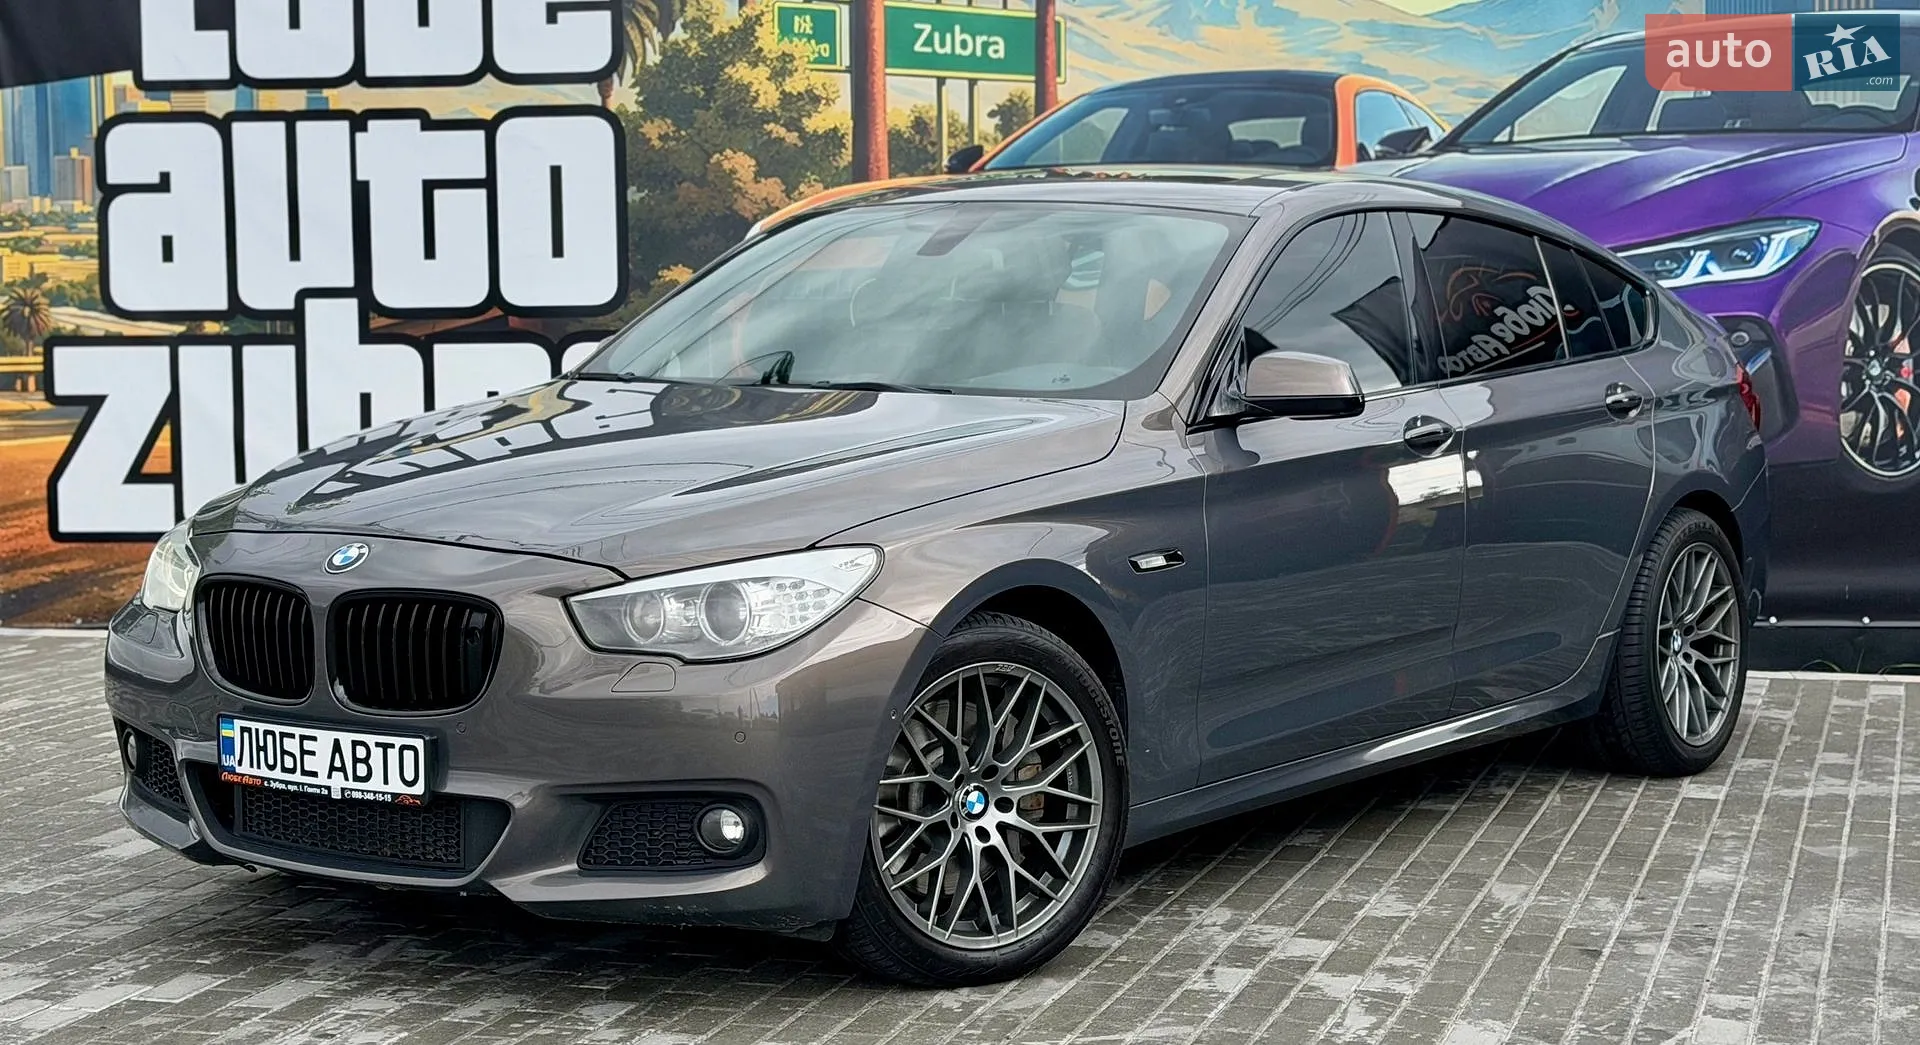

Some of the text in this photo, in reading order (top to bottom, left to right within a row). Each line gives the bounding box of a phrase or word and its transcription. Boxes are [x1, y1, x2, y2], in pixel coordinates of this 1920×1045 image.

[912, 22, 1006, 59] Zubra
[104, 114, 619, 312] auto
[221, 754, 236, 768] UA
[237, 725, 421, 788] ЛЮБЕ АВТО
